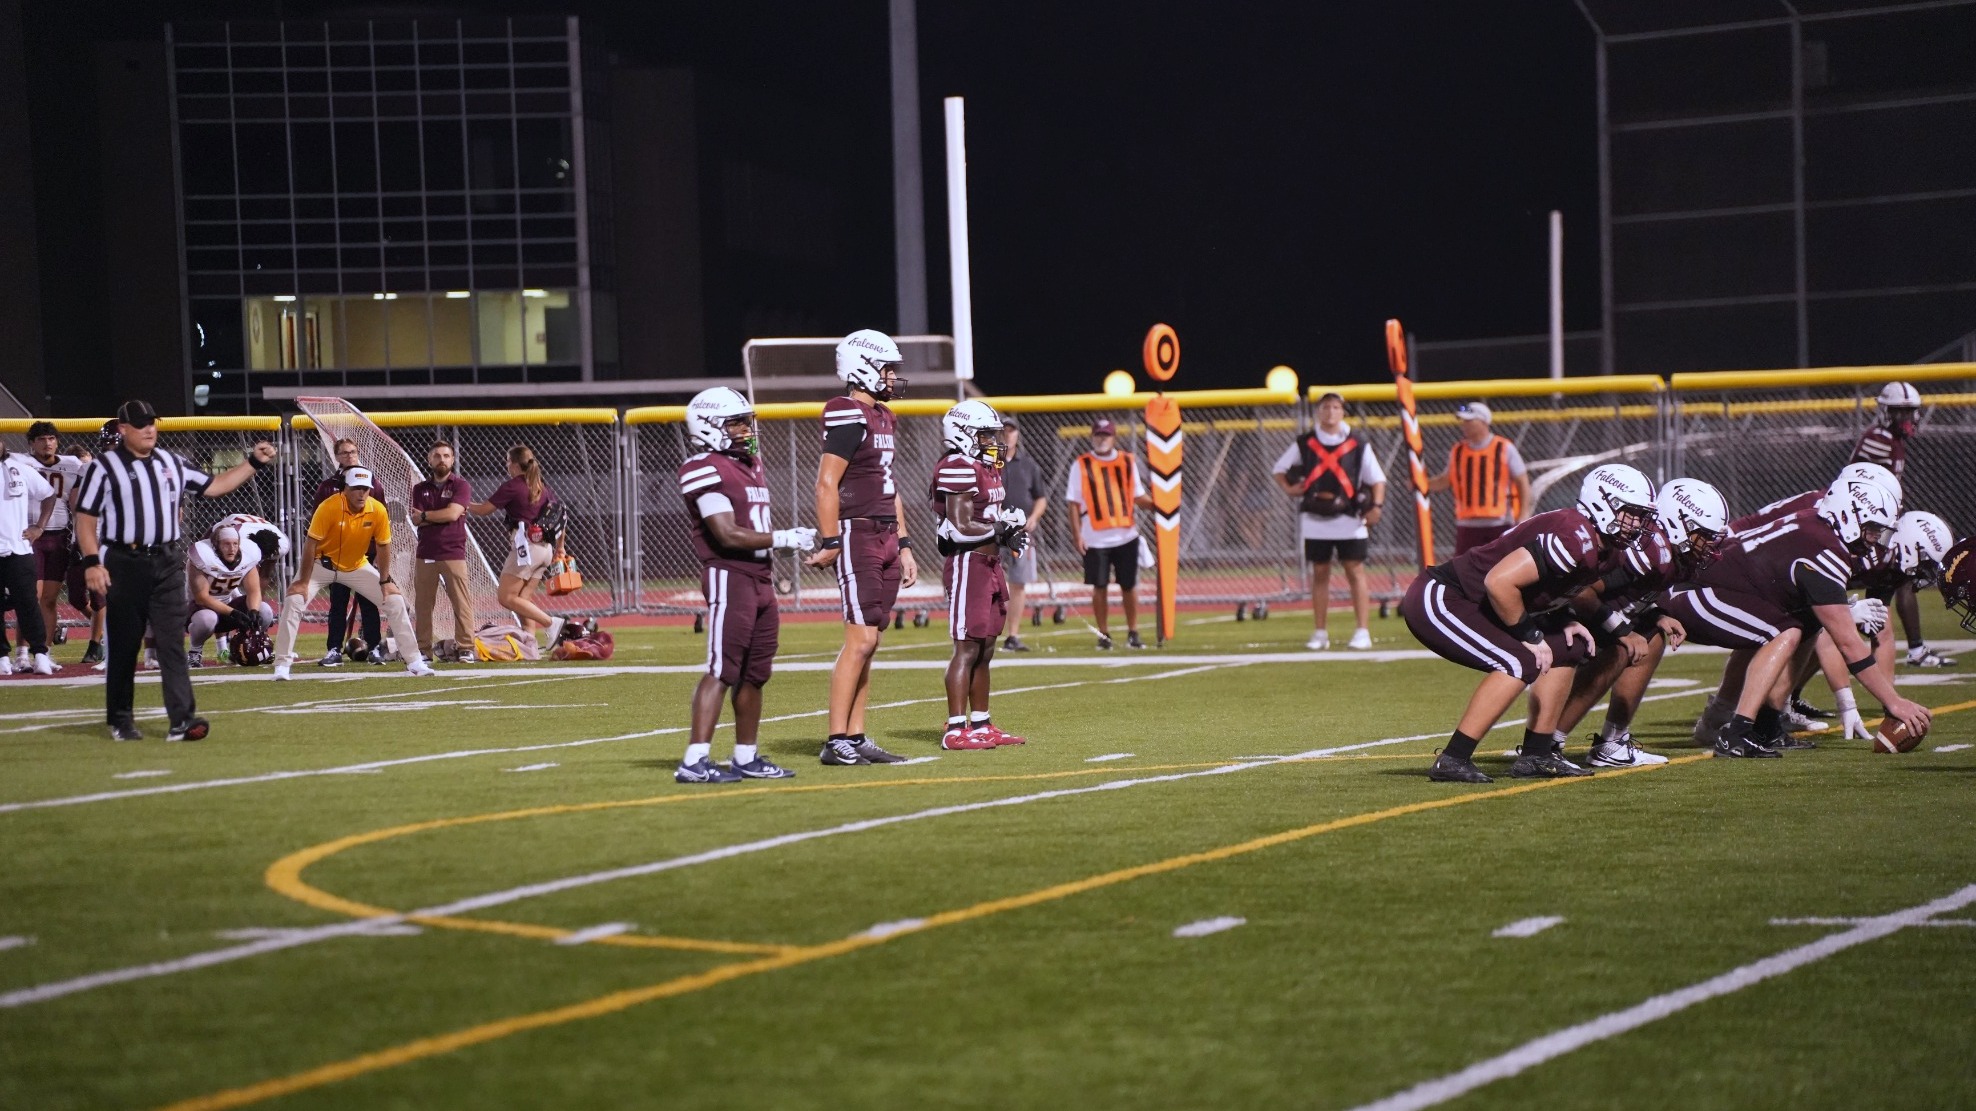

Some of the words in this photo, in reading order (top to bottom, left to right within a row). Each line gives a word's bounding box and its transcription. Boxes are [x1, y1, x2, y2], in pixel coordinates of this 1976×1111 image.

[848, 337, 884, 353] Falcons
[1672, 485, 1704, 517] Falcons
[1849, 485, 1879, 515] Falcons
[1918, 520, 1943, 553] Falcons
[518, 545, 527, 557] G
[209, 577, 241, 596] 55
